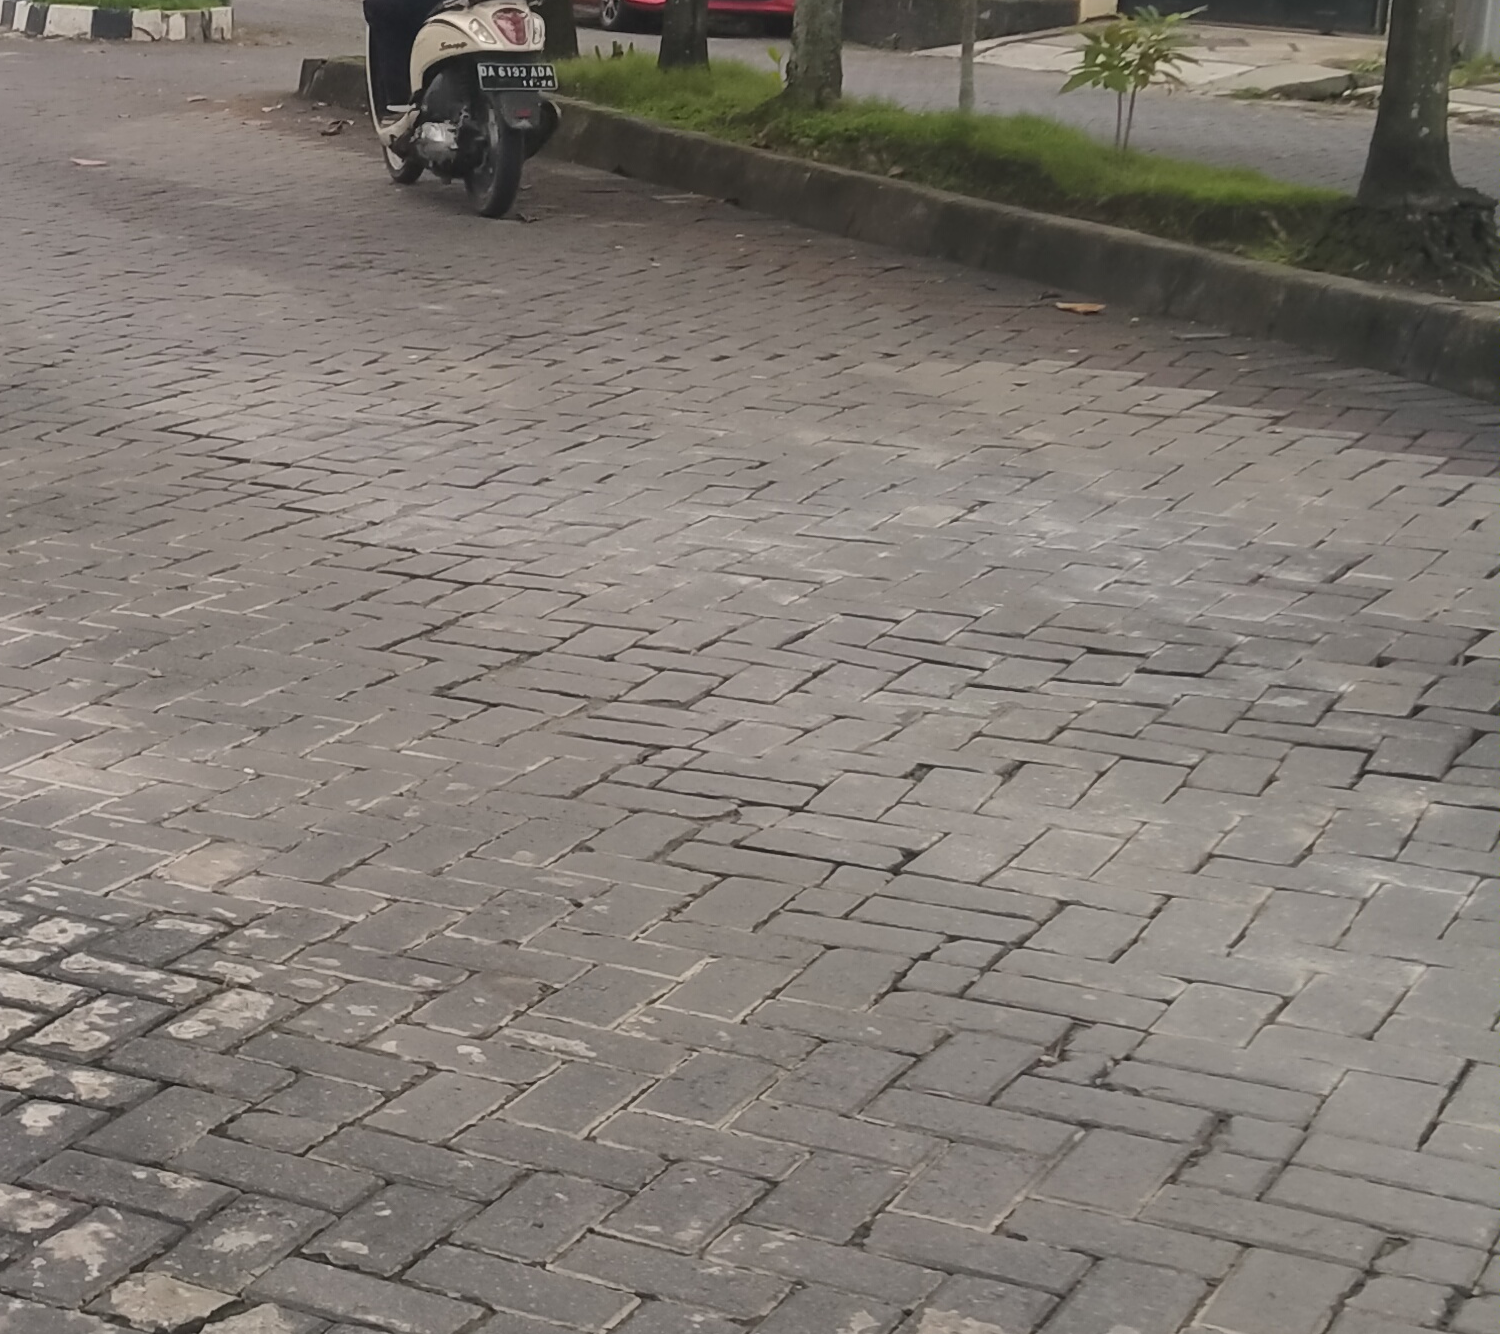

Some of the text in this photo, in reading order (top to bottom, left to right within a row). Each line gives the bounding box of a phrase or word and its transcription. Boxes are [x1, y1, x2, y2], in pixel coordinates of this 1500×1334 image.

[480, 66, 553, 77] DA 6193 ADA
